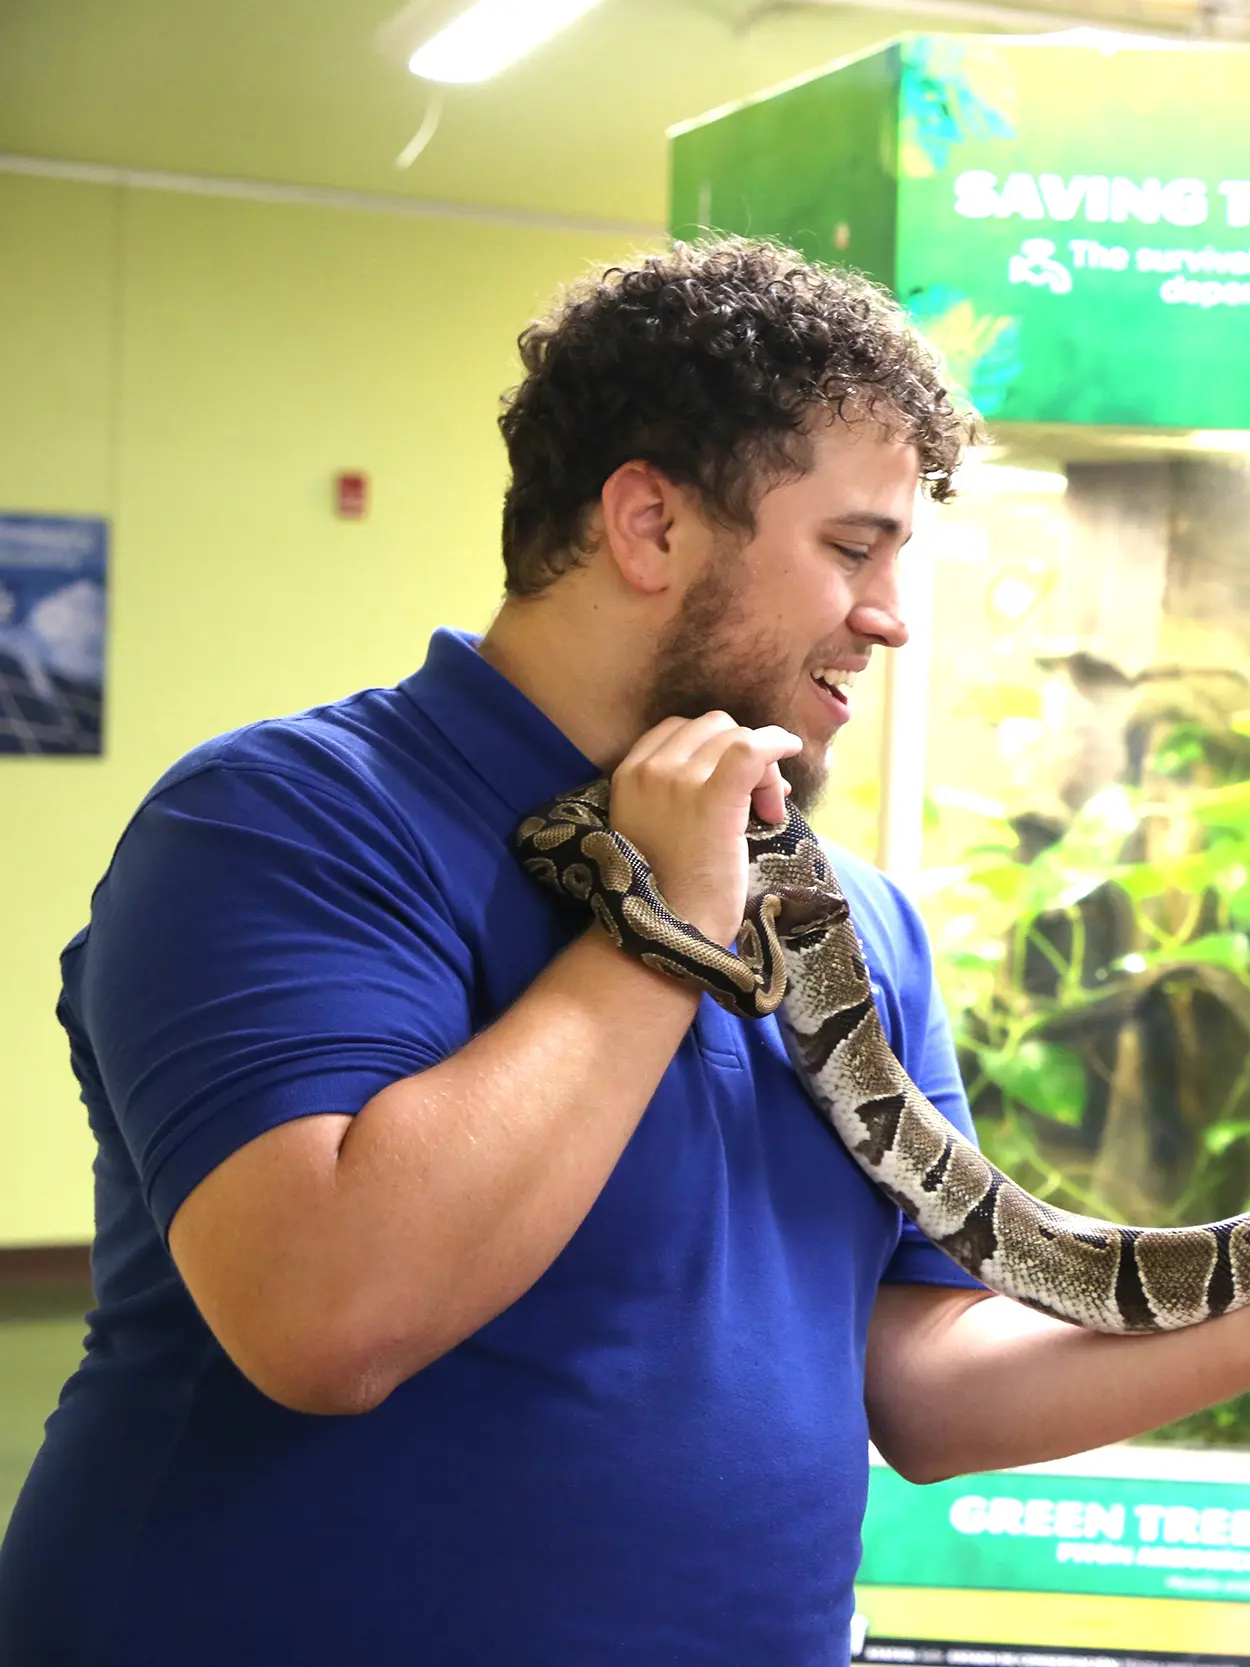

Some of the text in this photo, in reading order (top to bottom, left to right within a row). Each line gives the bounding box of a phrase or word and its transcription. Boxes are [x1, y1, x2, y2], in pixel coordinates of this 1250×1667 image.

[954, 169, 1208, 226] SAVING
[1071, 240, 1129, 270] The
[950, 1496, 1125, 1539] GREEN
